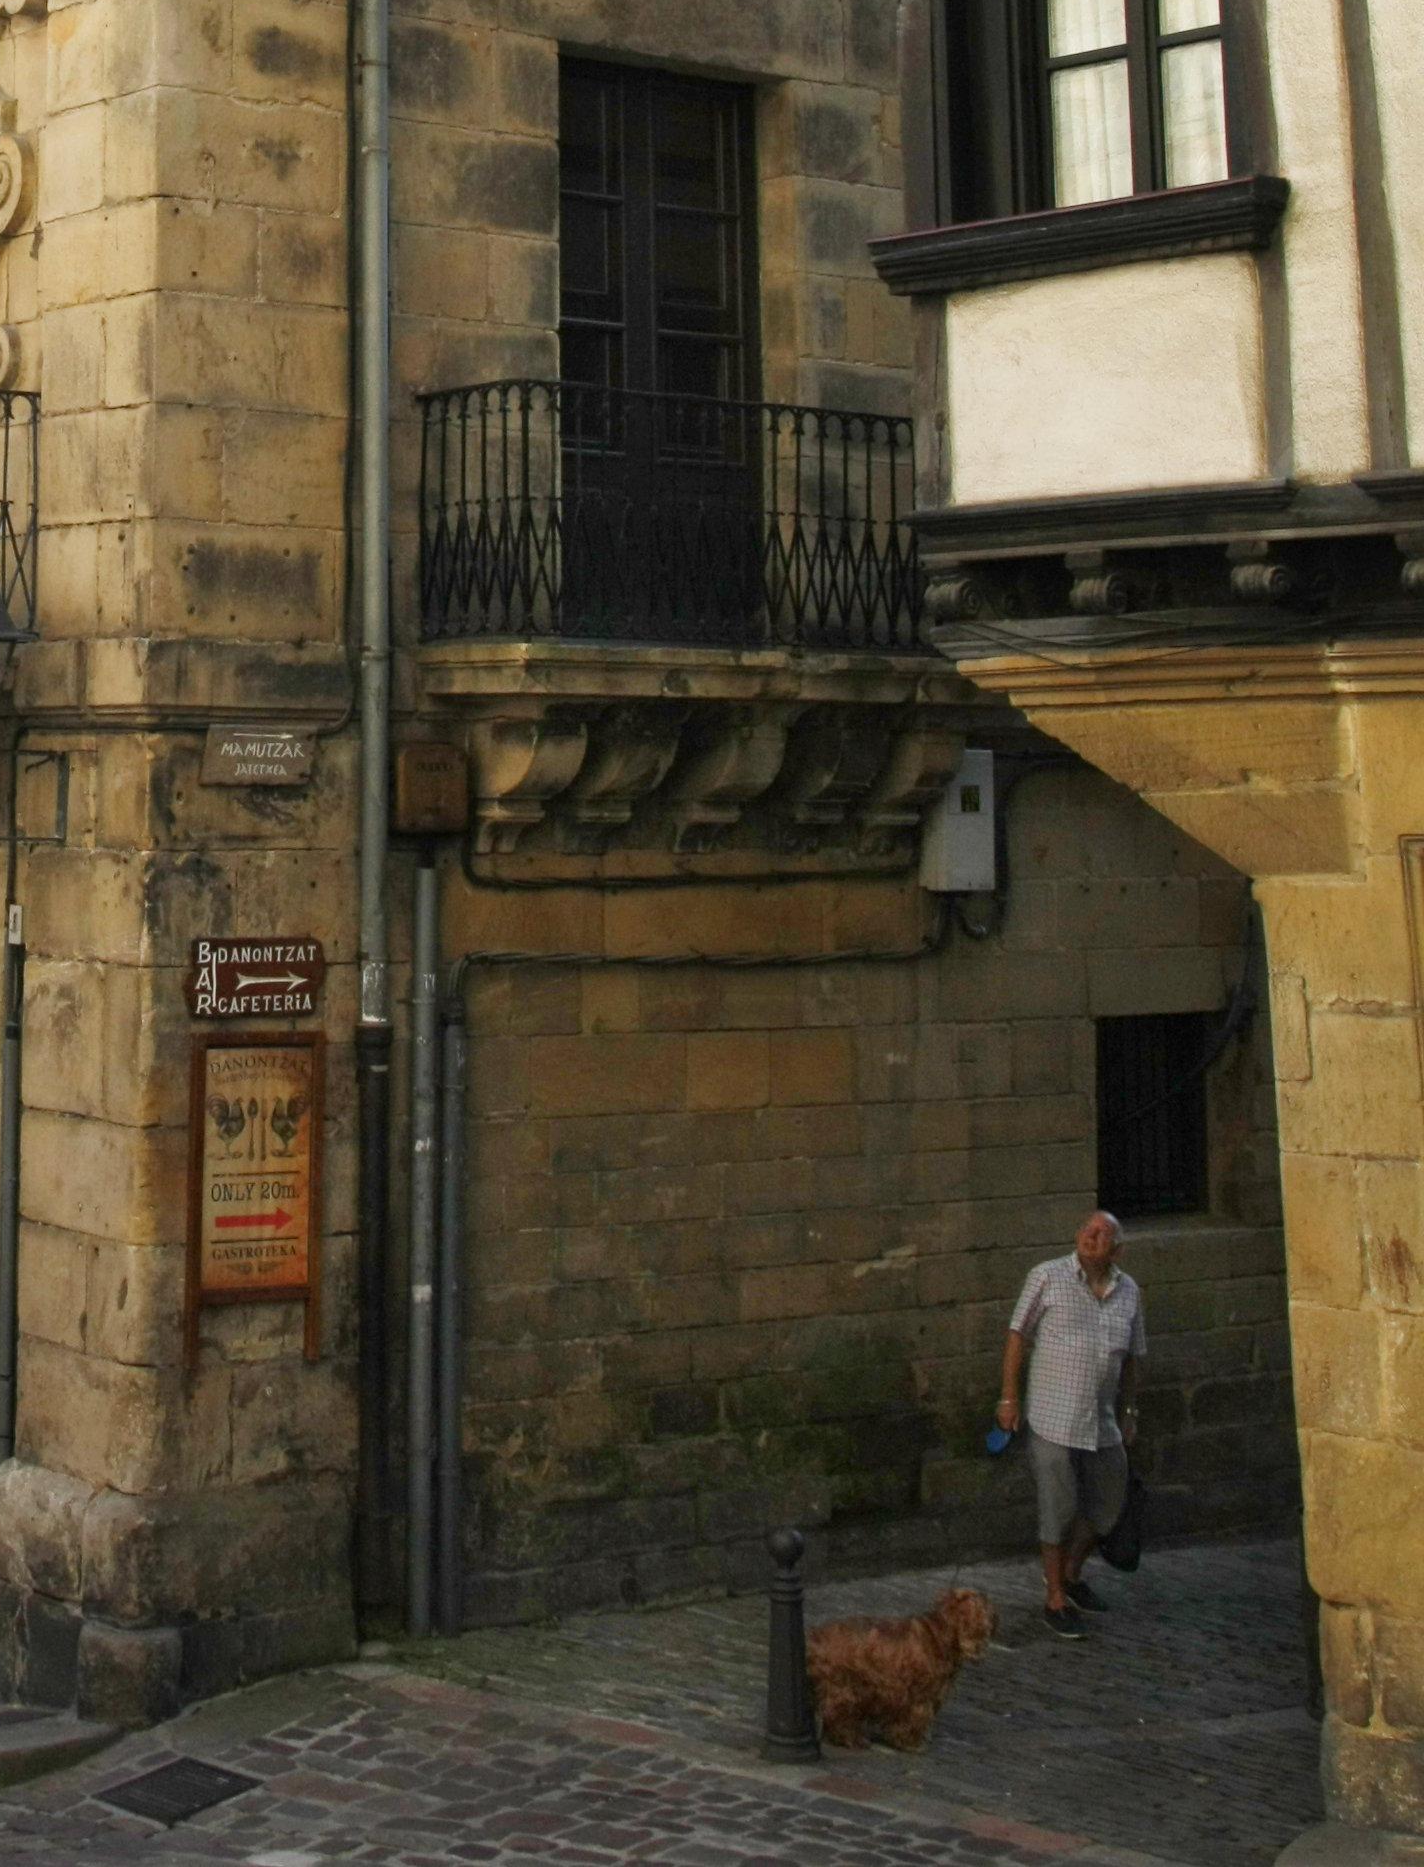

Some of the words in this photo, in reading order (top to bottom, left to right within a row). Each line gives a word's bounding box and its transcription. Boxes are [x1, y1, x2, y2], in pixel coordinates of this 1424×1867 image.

[221, 742, 304, 758] MAMUTZAR
[218, 945, 316, 963] DANONTZAT
[196, 942, 212, 1014] BAR
[210, 1054, 306, 1074] DANONTZAT
[211, 1183, 256, 1202] ONLY
[260, 1181, 300, 1200] 20m.
[212, 1245, 296, 1260] GASTROTEKA
